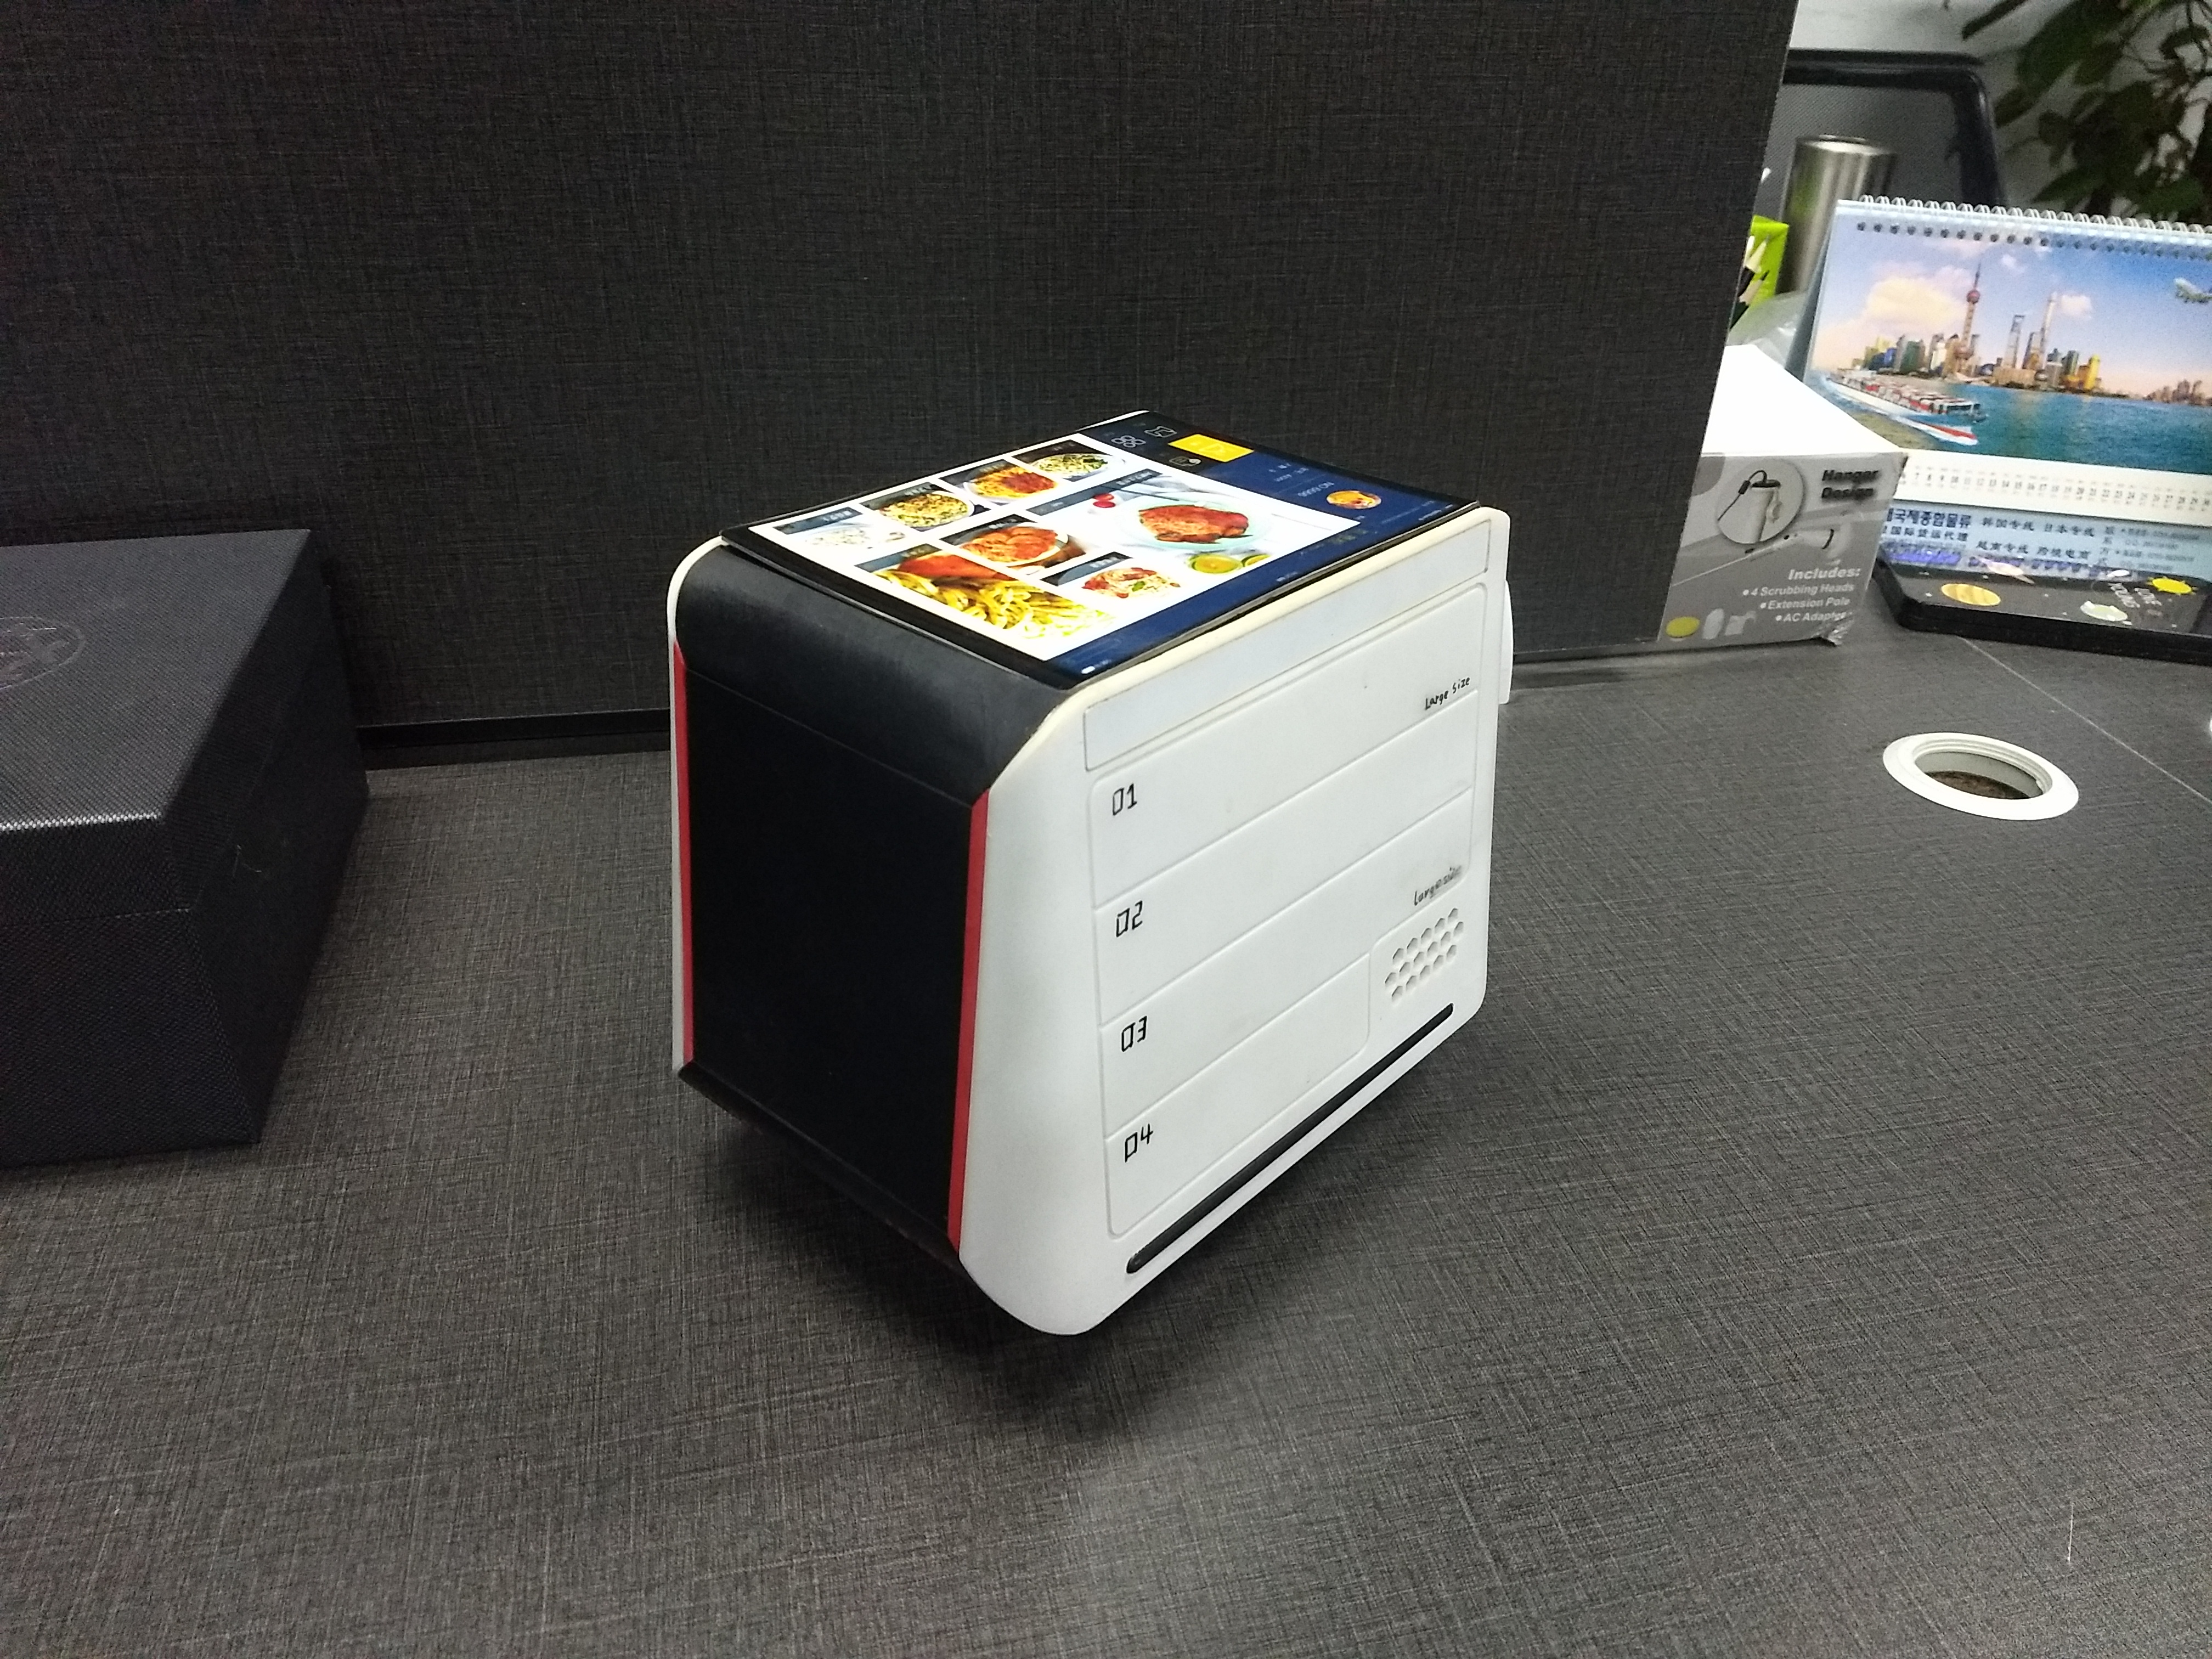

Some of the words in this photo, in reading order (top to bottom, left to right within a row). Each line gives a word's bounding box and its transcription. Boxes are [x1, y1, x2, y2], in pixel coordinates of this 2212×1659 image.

[1788, 567, 1861, 580] Includes:
[1760, 585, 1818, 596] Scrubbing
[1768, 599, 1824, 609] Extension
[1111, 783, 1138, 815] 01
[1116, 900, 1143, 937] 02
[1121, 1015, 1148, 1052] 03
[1124, 1124, 1154, 1163] 04
